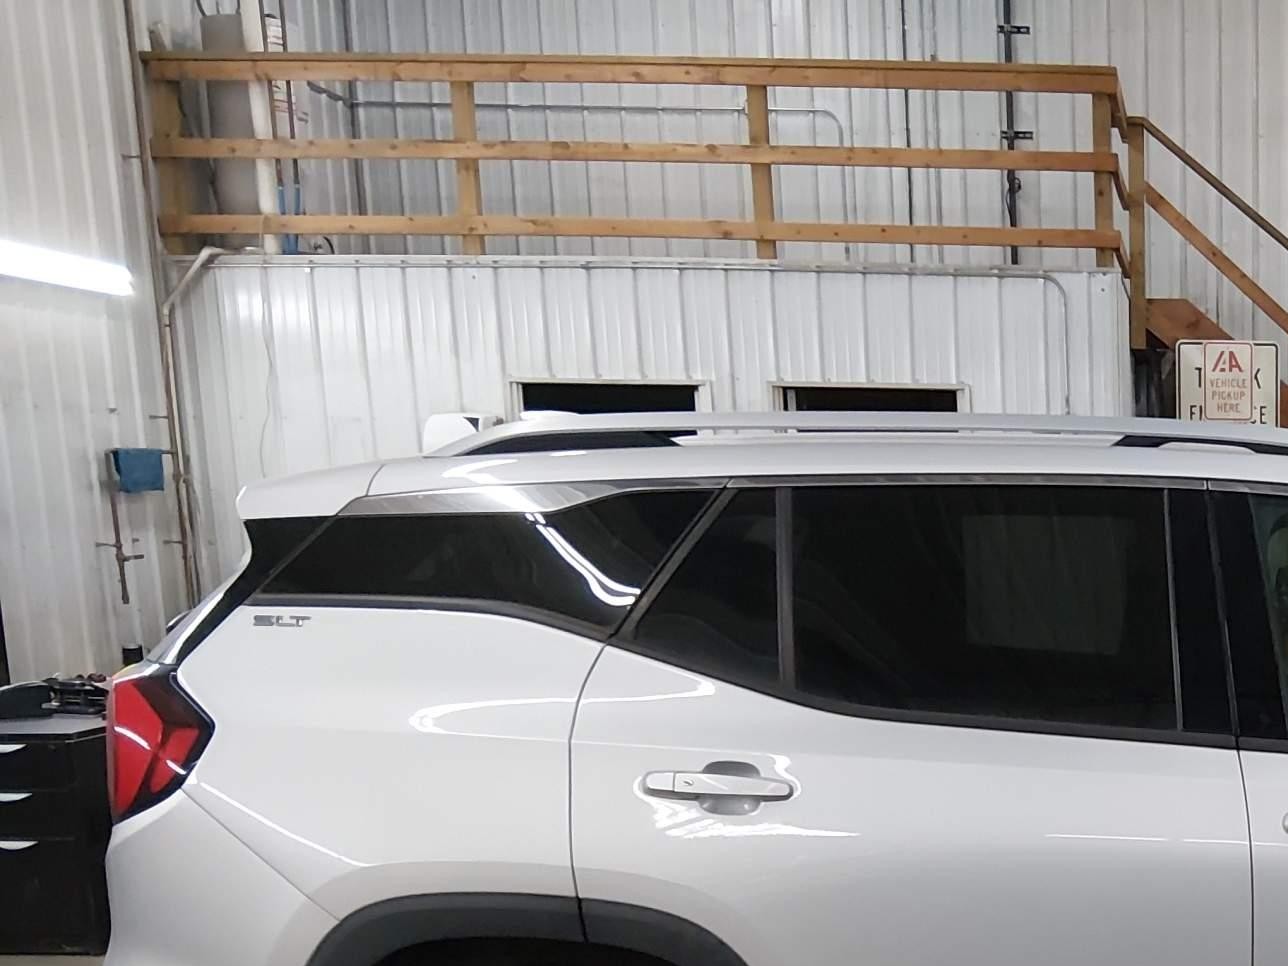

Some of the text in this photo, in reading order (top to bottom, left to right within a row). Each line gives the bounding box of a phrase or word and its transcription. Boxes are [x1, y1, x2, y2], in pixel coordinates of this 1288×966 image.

[1210, 378, 1248, 388] VEHICLE
[1211, 390, 1246, 400] PICKUP
[1217, 402, 1240, 413] HERE
[253, 614, 312, 627] SLT
